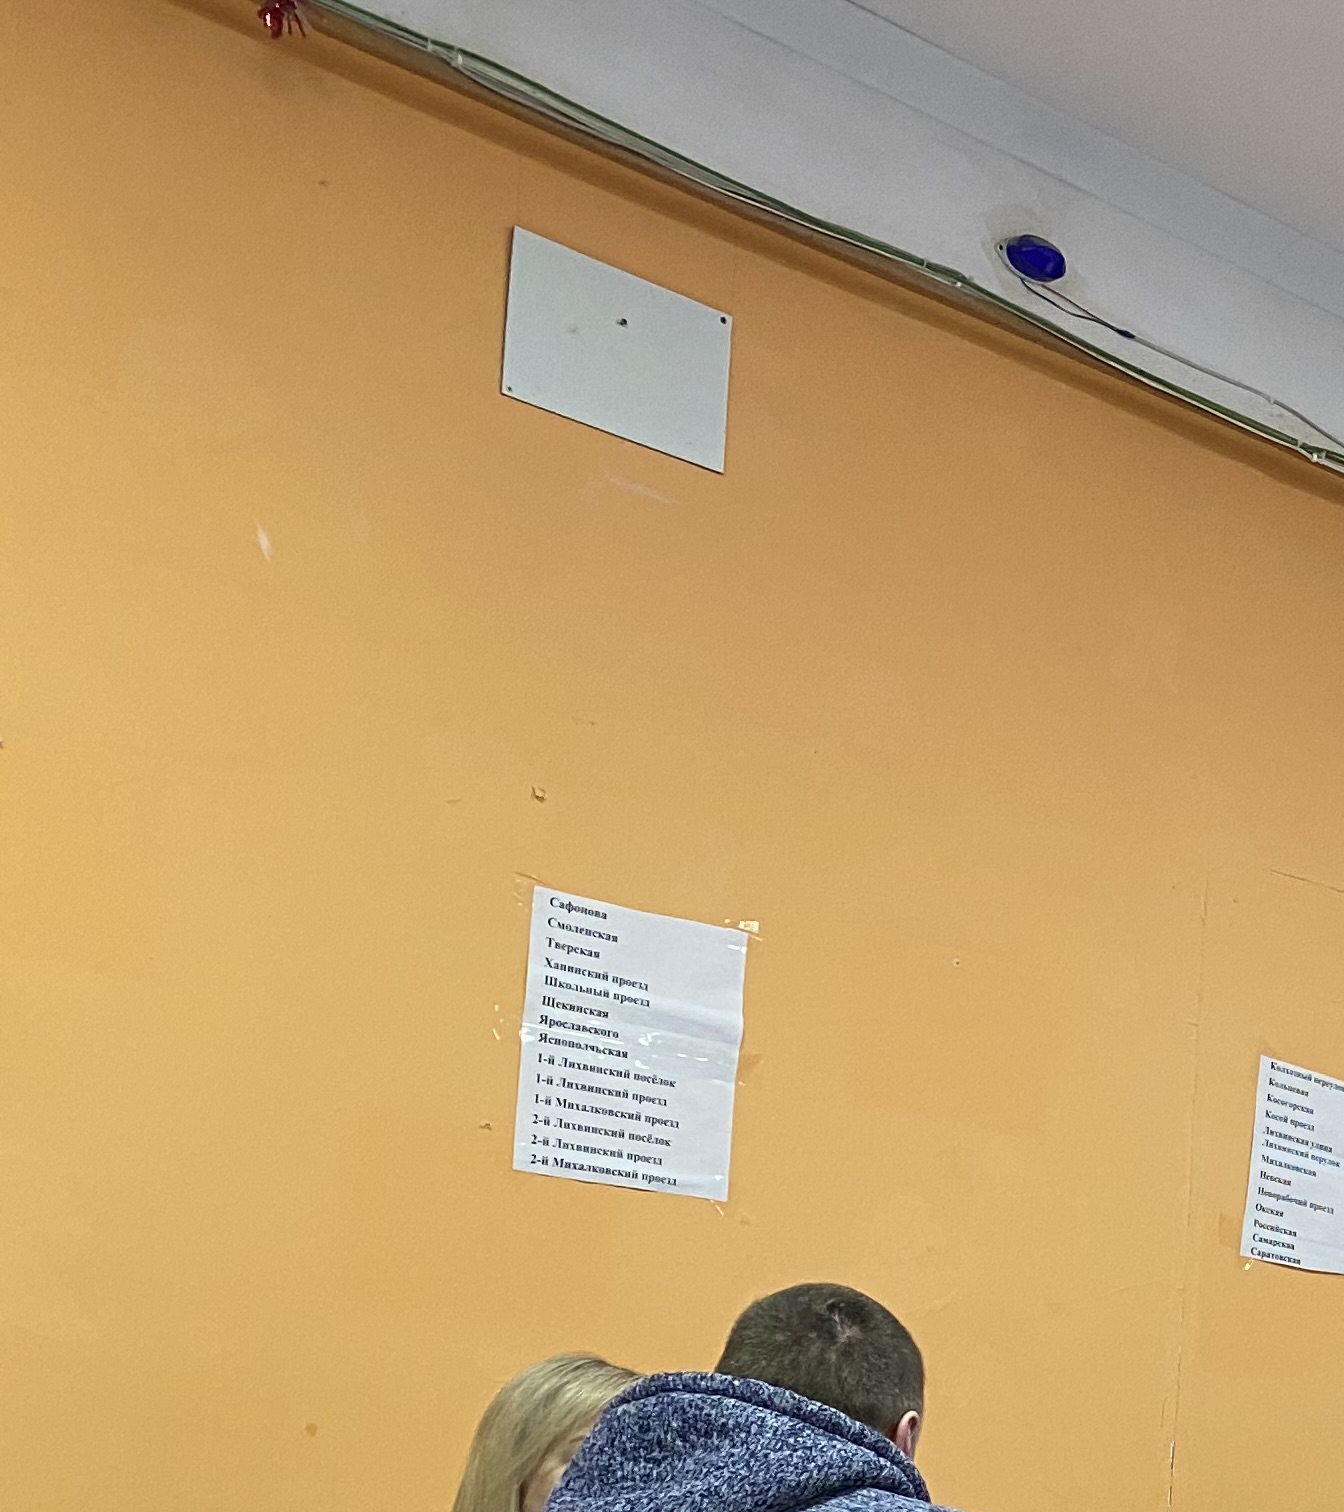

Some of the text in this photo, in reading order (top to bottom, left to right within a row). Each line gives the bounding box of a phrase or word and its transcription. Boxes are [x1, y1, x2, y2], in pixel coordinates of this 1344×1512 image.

[550, 897, 607, 920] Сафонова
[547, 917, 618, 943] Смоленская
[545, 937, 600, 959] Тверская
[544, 957, 649, 992] Ханинский проезд
[544, 975, 650, 1008] Школьный проезд
[541, 995, 609, 1019] Щекинская
[538, 1014, 619, 1039] Ярославского
[537, 1053, 677, 1088] 1-й Лихвинский посёлок
[536, 1073, 668, 1107] 1-й Лихвинский проезд
[534, 1093, 680, 1129] 1-й Михалковский проезд
[532, 1114, 673, 1147] 2-й Лихвинский посёлок
[1290, 1119, 1315, 1132] проезд
[531, 1134, 663, 1167] 2-й Лихвинский проезд
[530, 1154, 677, 1186] 2-й Михалковский проезд
[1259, 1170, 1292, 1186] Невская
[1253, 1218, 1297, 1237] Российская
[1252, 1233, 1295, 1250] Самарская
[1250, 1247, 1301, 1265] Саратовская
